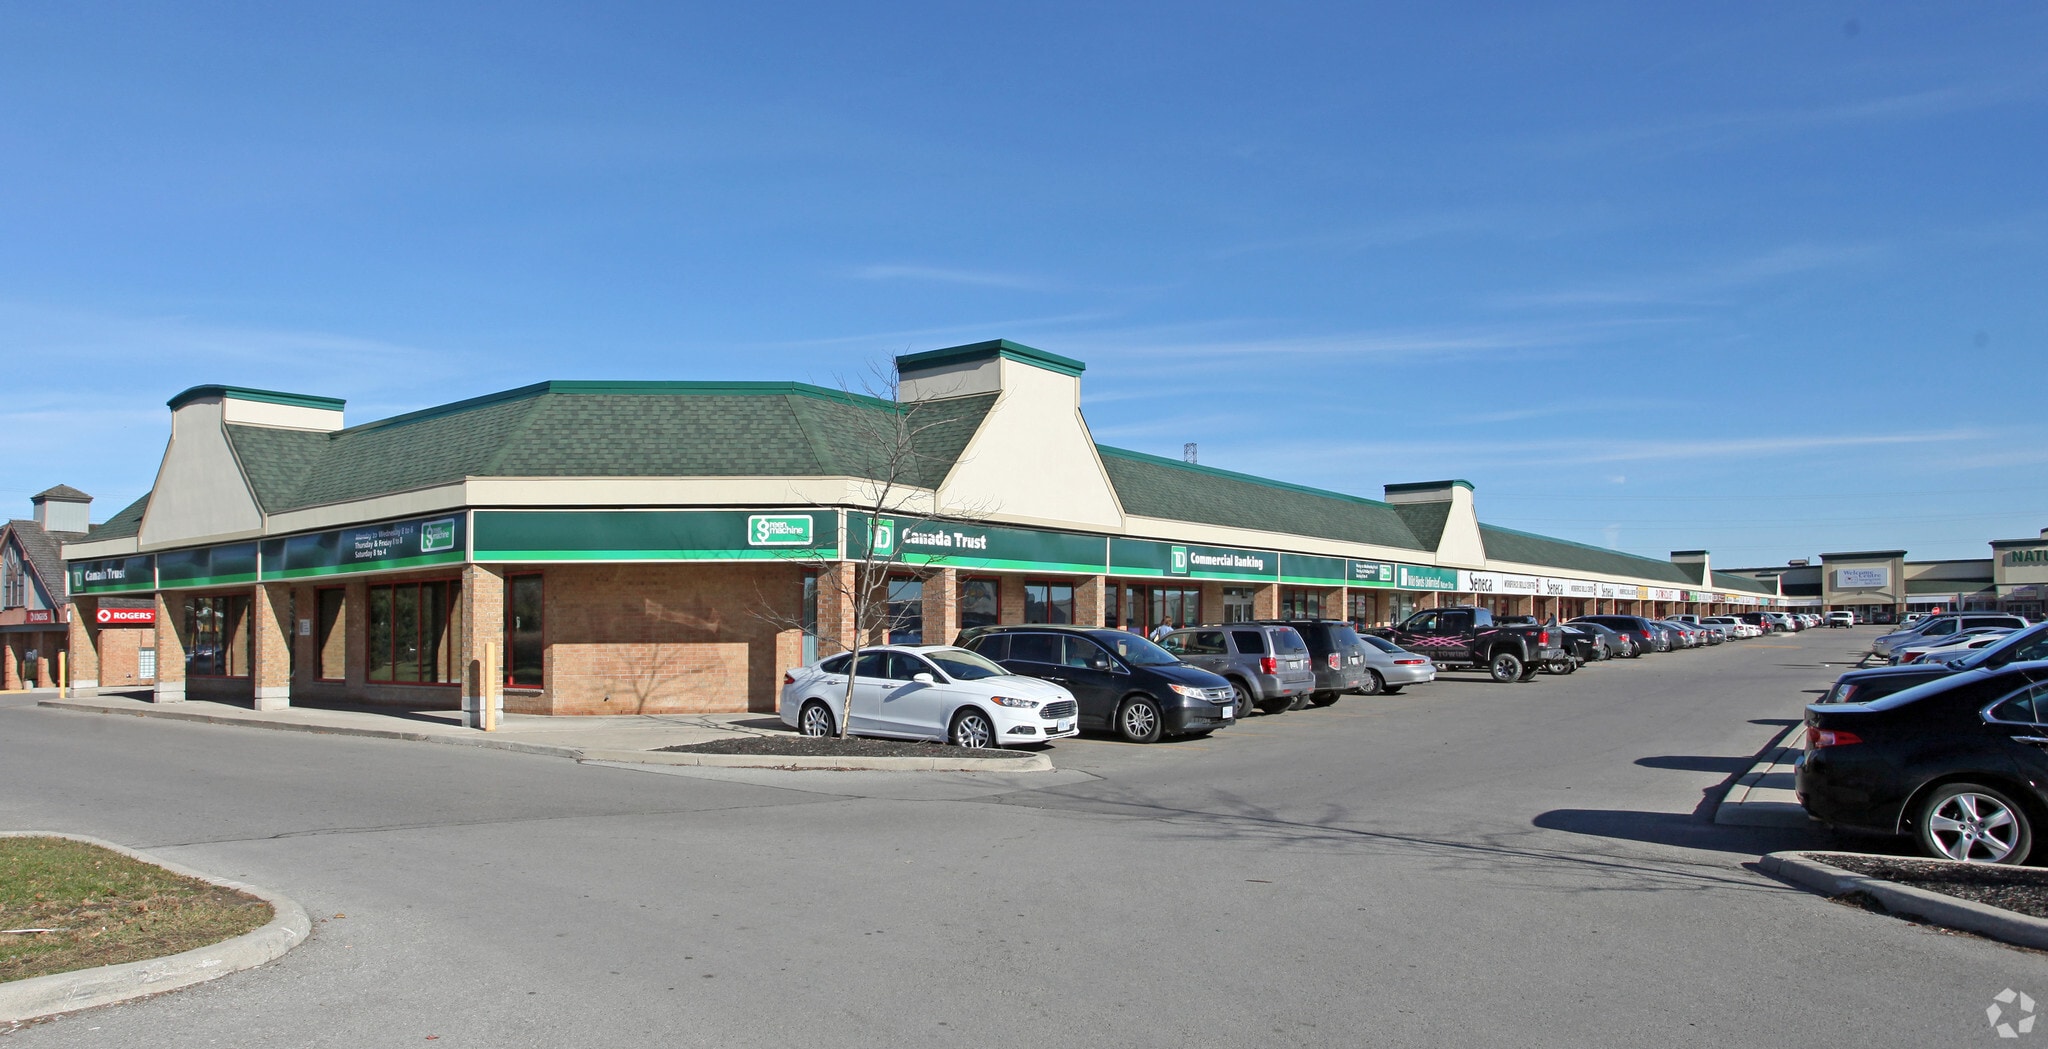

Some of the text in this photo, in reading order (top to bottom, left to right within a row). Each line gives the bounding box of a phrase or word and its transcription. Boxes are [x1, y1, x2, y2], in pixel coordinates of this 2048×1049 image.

[769, 526, 803, 534] machine
[355, 541, 373, 549] Thursday
[378, 539, 392, 548] Friday
[902, 528, 952, 546] Canada
[954, 532, 987, 550] Trust
[355, 550, 373, 559] Saturday
[1173, 551, 1263, 571] TD Commercial Banking
[85, 569, 106, 581] Canada
[107, 567, 125, 579] Trust
[1469, 572, 1493, 592] Seneca
[1547, 579, 1563, 595] Seneca
[113, 612, 152, 620] ROGERS
